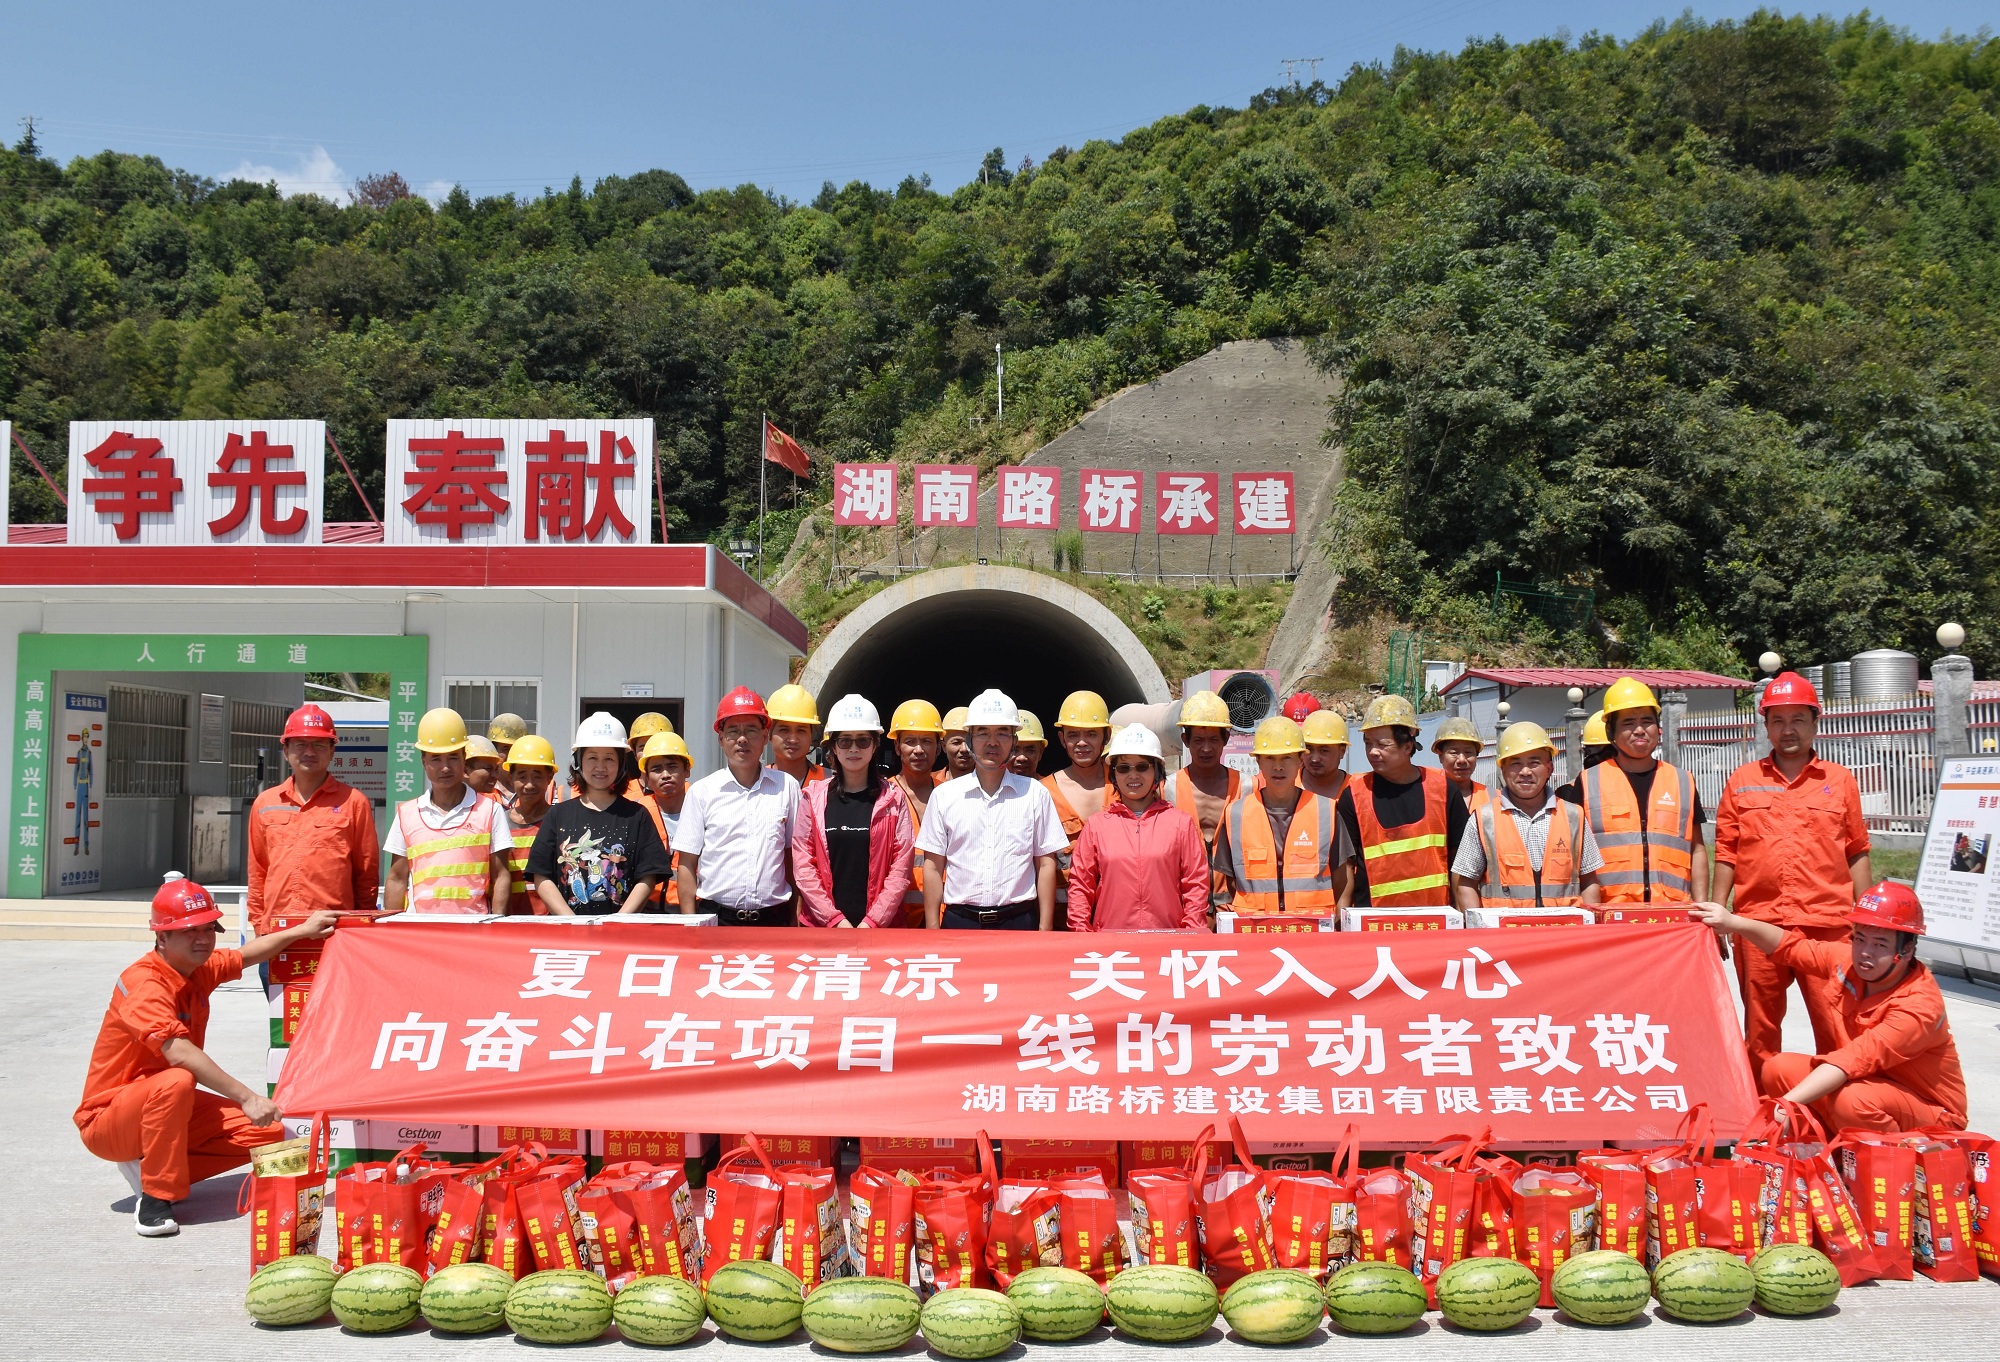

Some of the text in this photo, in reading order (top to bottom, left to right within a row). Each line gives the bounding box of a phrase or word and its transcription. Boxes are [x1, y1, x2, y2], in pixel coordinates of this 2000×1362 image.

[83, 431, 307, 540] 争先
[402, 430, 635, 541] 奉献
[840, 468, 1291, 531] 湖南路桥承建
[136, 643, 307, 664] 人行通道
[18, 680, 45, 876] 高高兴兴上班去
[394, 681, 418, 812] 平平安安
[371, 1012, 1678, 1077] 向奋斗在项目一线的劳动者致敬
[962, 1084, 1688, 1115] 湖南路桥建设集团有限责任公司
[503, 1127, 573, 1142] 慰问物资
[607, 1142, 680, 1157] 慰问物资
